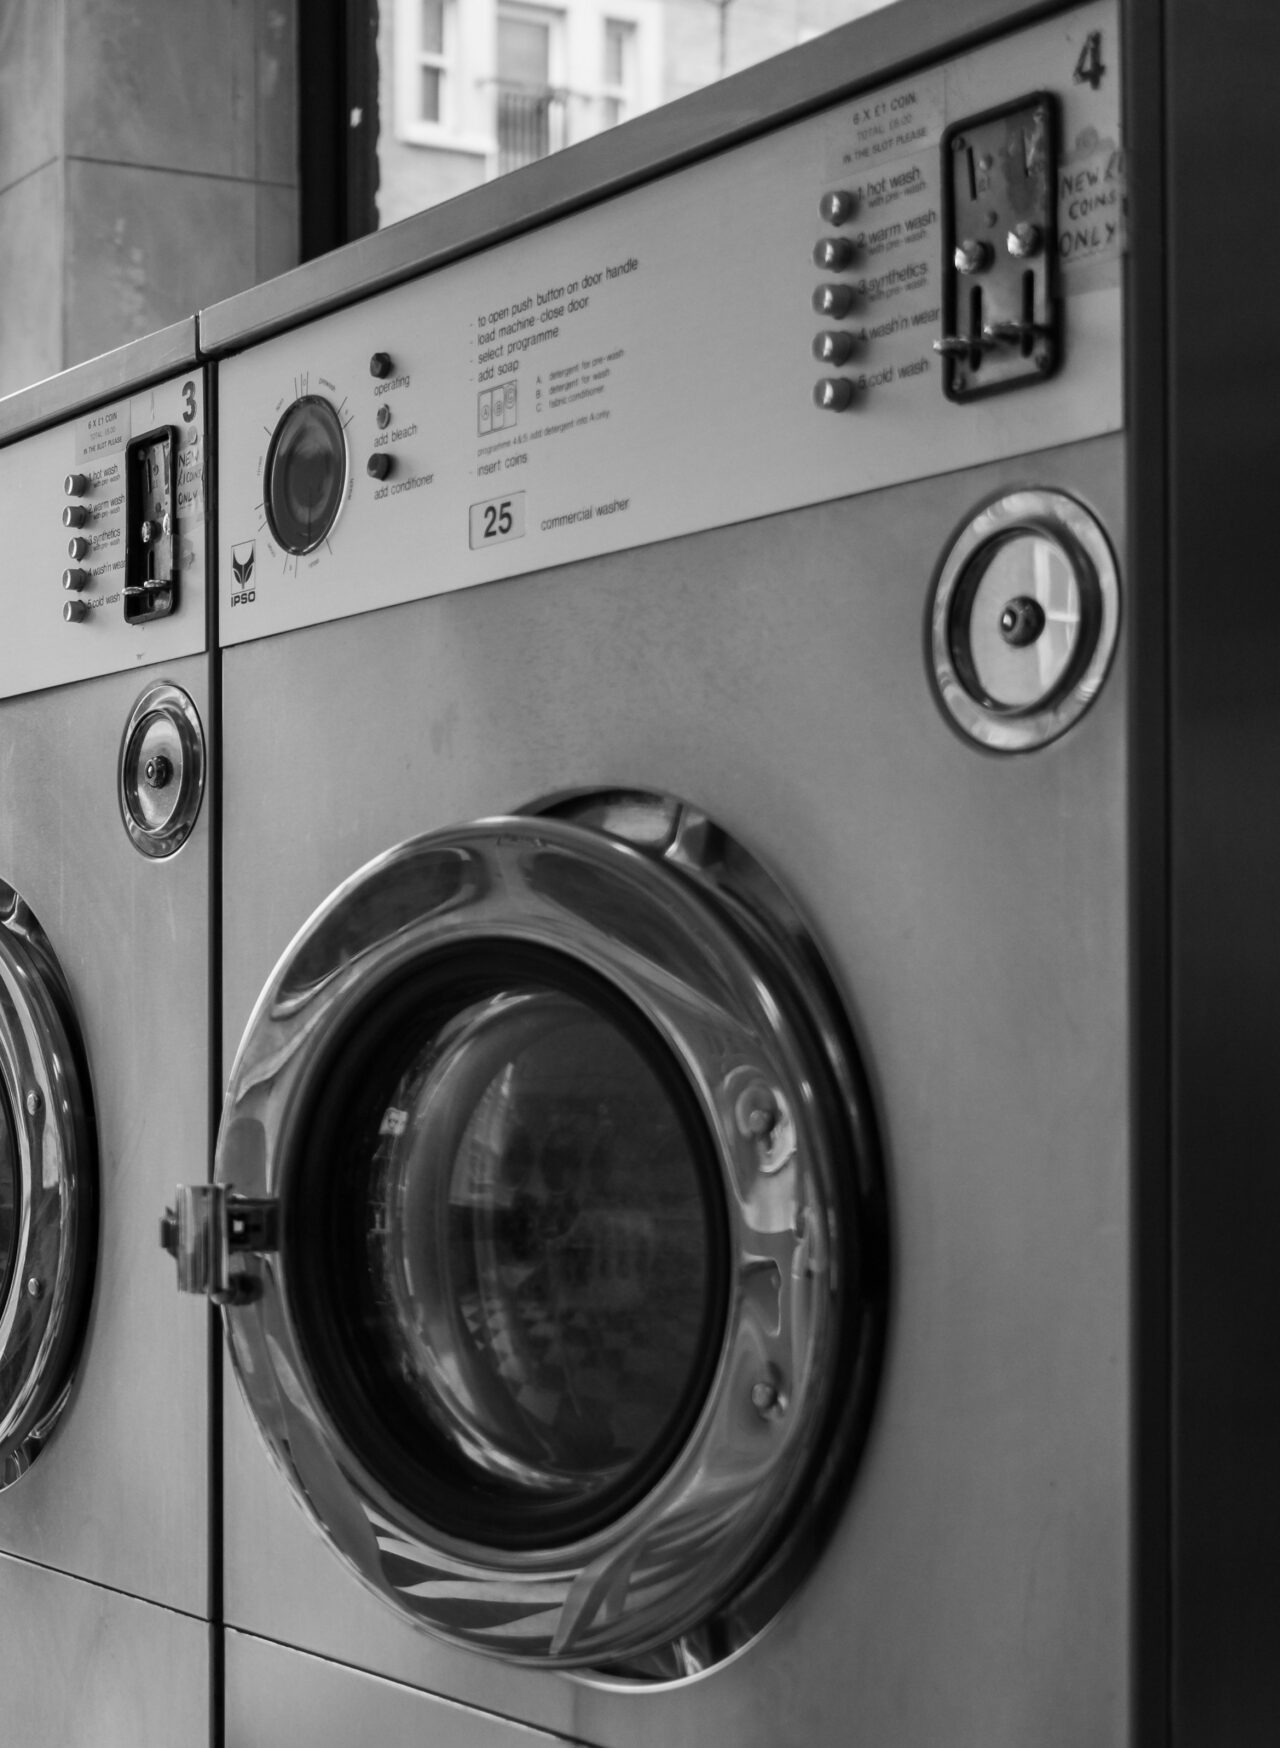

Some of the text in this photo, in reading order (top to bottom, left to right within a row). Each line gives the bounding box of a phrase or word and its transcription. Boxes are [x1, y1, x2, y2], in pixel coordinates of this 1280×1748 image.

[1073, 31, 1106, 90] 4
[852, 112, 860, 126] 6
[890, 91, 918, 111] COIN
[896, 126, 927, 145] PLEASE
[866, 177, 886, 196] hot
[889, 165, 921, 189] wash
[1060, 167, 1099, 199] NEW
[1068, 189, 1117, 221] COINS
[868, 223, 901, 244] warm
[904, 207, 936, 232] wash
[1060, 221, 1116, 259] ONLY
[477, 257, 638, 328] to open push button on door handle
[868, 262, 928, 293] synthetics
[477, 330, 496, 346] load
[498, 317, 535, 338] machine
[540, 305, 564, 323] close
[567, 296, 590, 314] door
[911, 308, 940, 327] wear
[477, 326, 559, 365] select programme
[373, 375, 410, 398] operating
[477, 359, 519, 383] add soap
[868, 364, 893, 388] cold
[897, 356, 929, 379] wash
[181, 380, 197, 423] 3
[373, 423, 418, 448] add bleach
[477, 452, 528, 477] insert coins
[373, 486, 389, 501] add
[390, 473, 434, 497] conditioner
[483, 501, 513, 539] 25
[540, 496, 631, 532] commercial washer
[230, 590, 256, 608] IPSO
